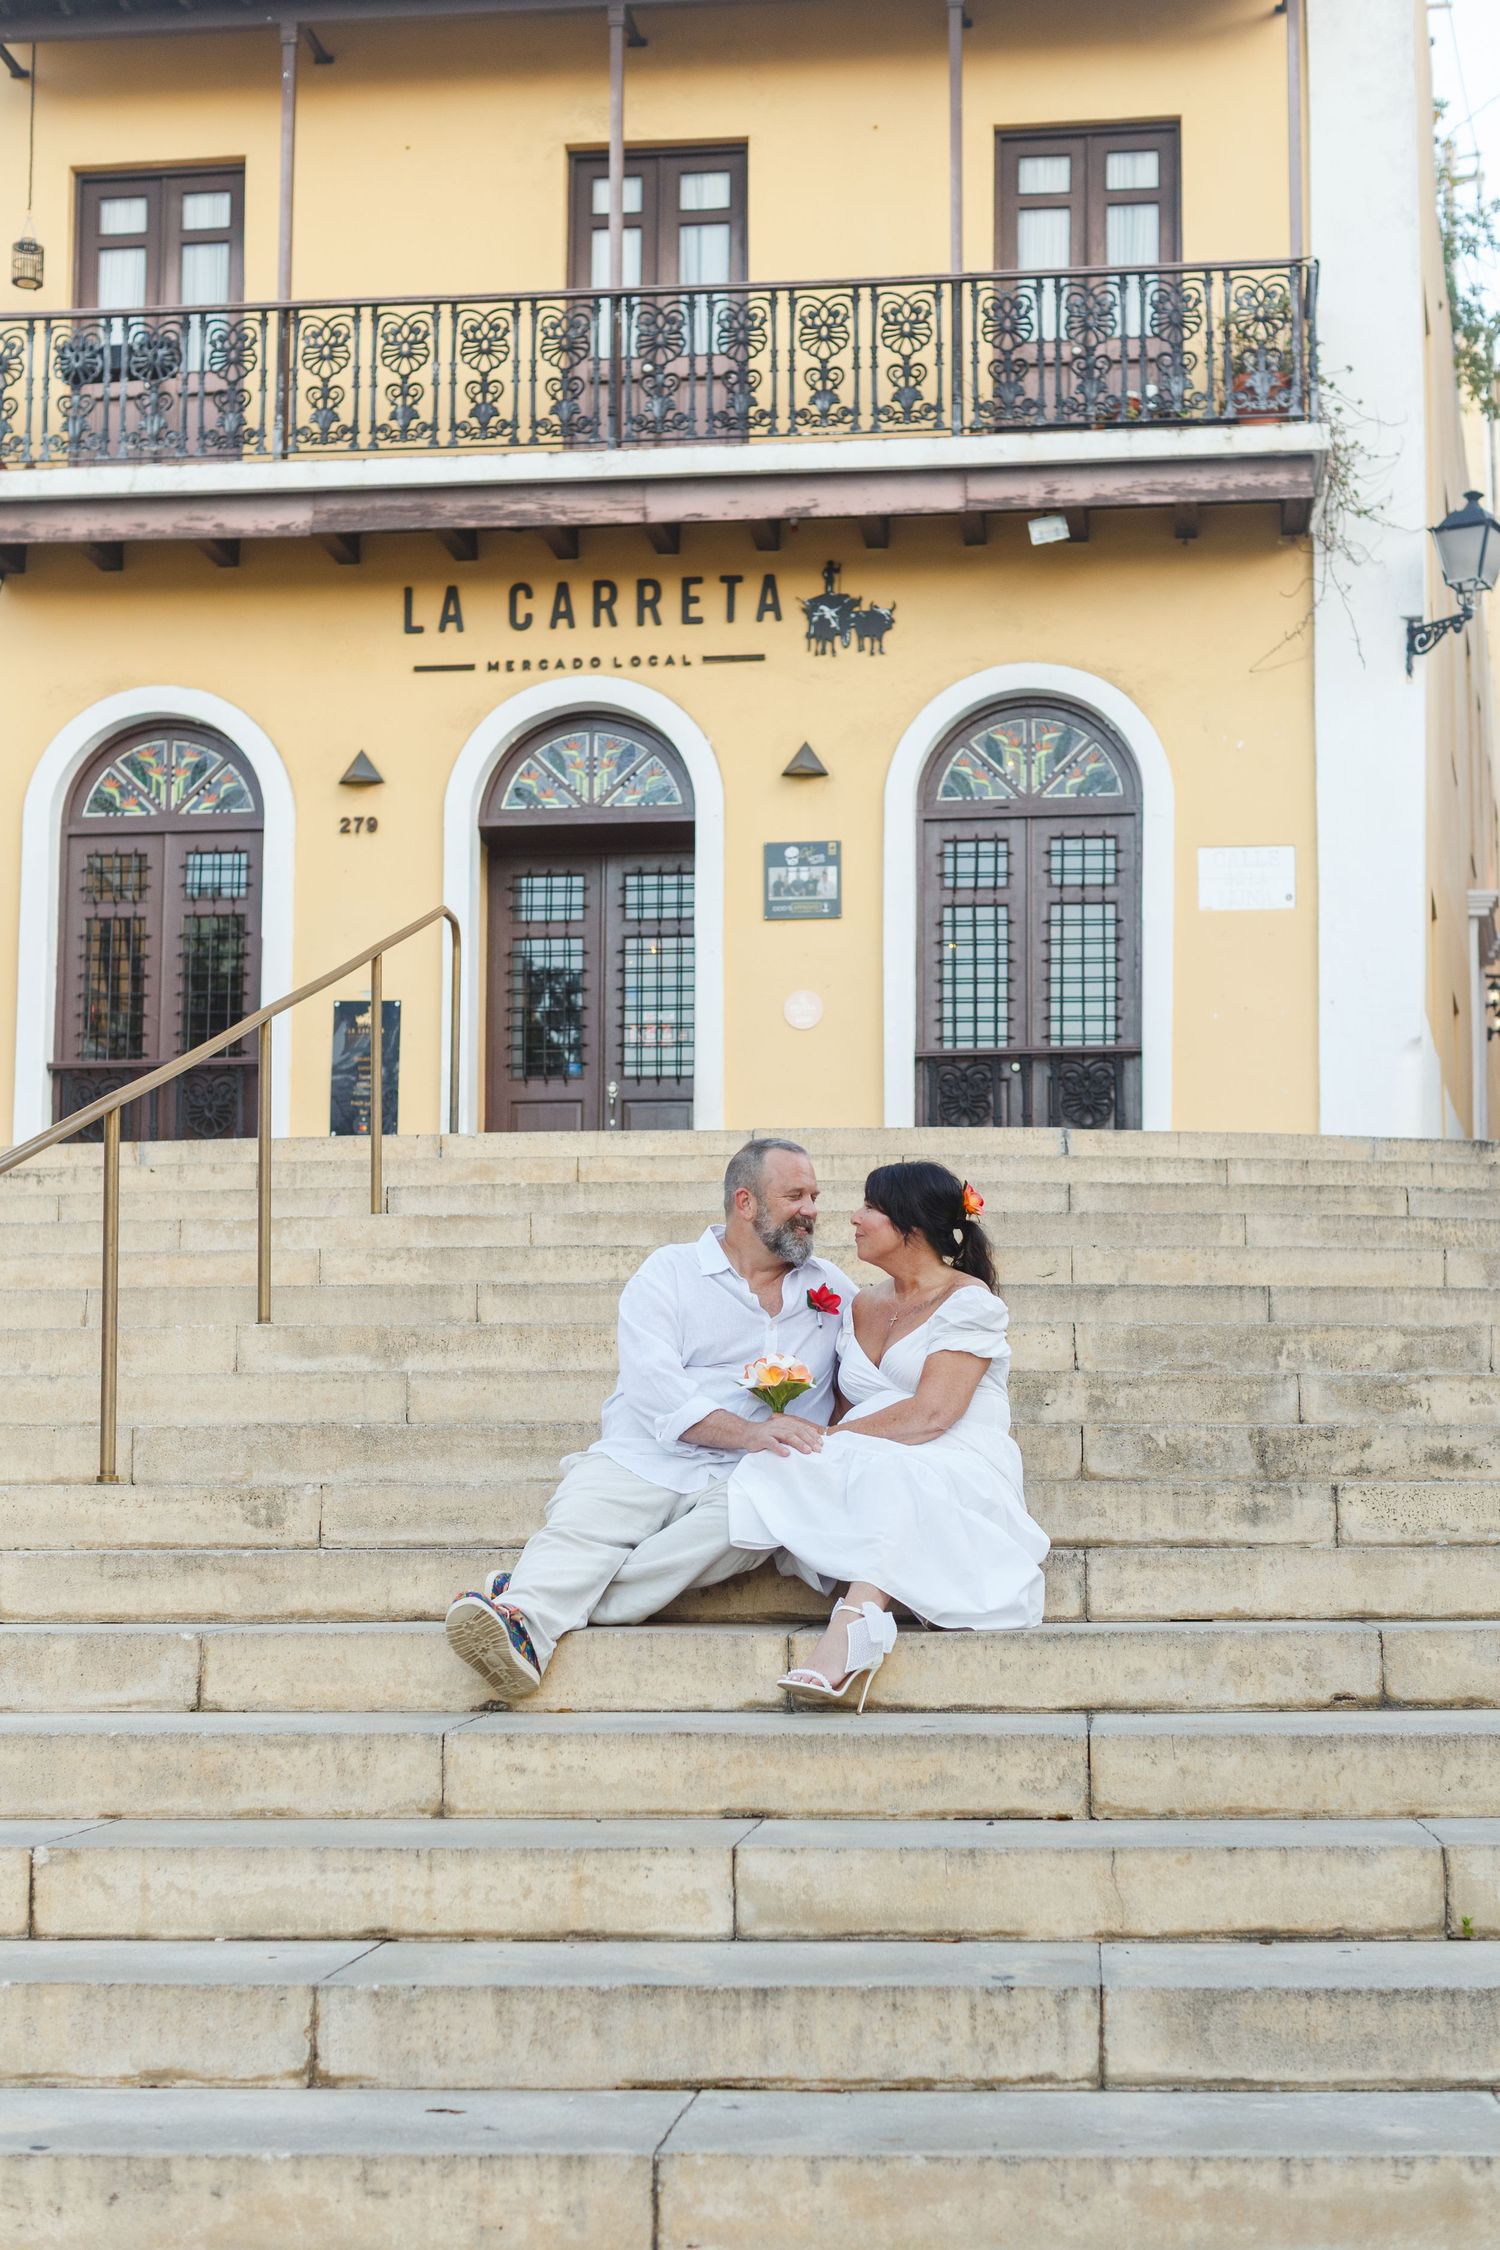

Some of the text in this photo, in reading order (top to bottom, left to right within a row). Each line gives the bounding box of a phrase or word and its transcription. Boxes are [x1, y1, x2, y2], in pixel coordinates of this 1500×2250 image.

[403, 573, 783, 635] LA CARRETA
[487, 653, 692, 673] MERCADO LOCAL
[339, 816, 379, 834] 279
